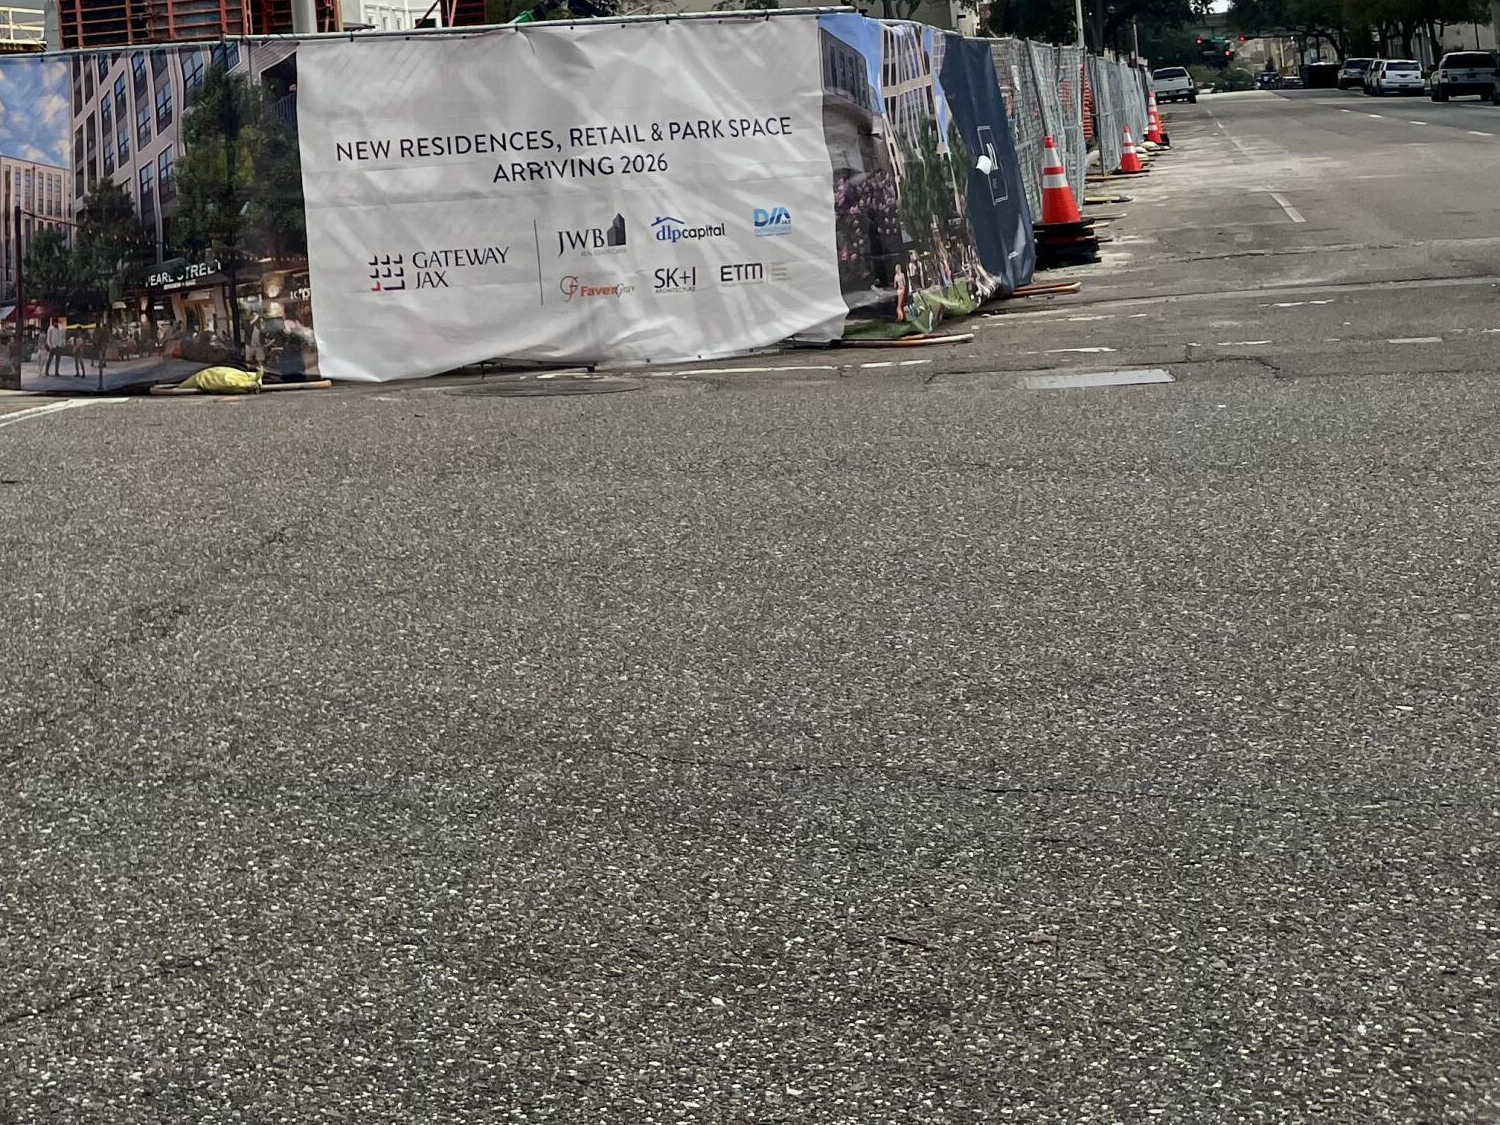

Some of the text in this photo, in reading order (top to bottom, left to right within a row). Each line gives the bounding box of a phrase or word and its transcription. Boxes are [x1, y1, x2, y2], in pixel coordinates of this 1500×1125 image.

[336, 116, 793, 161] NEW RESIDENCES, RETAIL & PARK SPACE
[493, 153, 668, 183] ARRIVING 2026
[558, 228, 605, 256] JWB
[412, 246, 510, 269] GATEWAY
[415, 270, 449, 290] JAX
[720, 262, 763, 282] ETM
